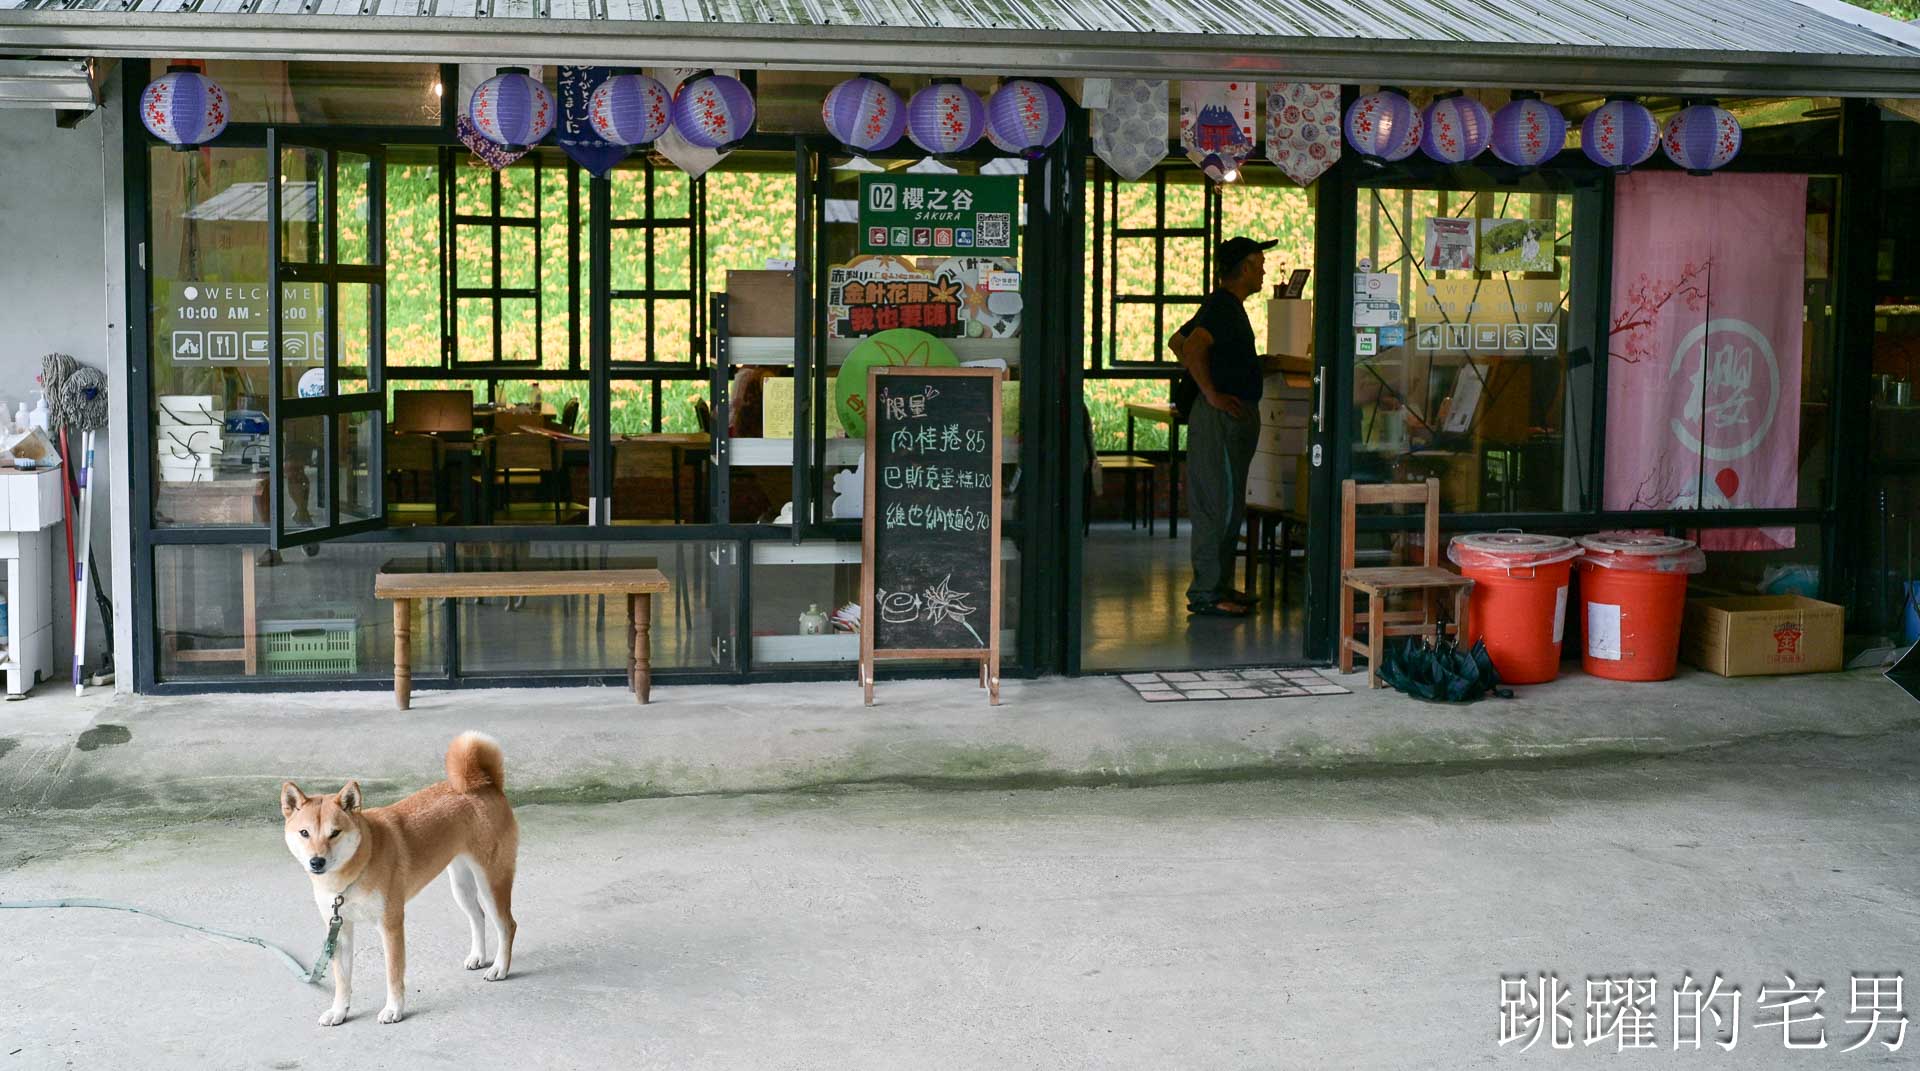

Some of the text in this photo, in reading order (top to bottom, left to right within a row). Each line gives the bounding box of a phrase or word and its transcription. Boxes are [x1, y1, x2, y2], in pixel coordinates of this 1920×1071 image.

[872, 186, 974, 211] 02 櫻之谷
[915, 212, 961, 221] SAKURA
[205, 288, 311, 300] WELCME
[843, 281, 929, 304] 金針花開
[178, 307, 218, 320] 10:00
[228, 307, 249, 320] AM
[1536, 301, 1553, 313] PM
[886, 394, 928, 420] 限量
[891, 424, 986, 454] 肉桂捲 85
[975, 473, 992, 488] 120
[976, 511, 990, 531] 70
